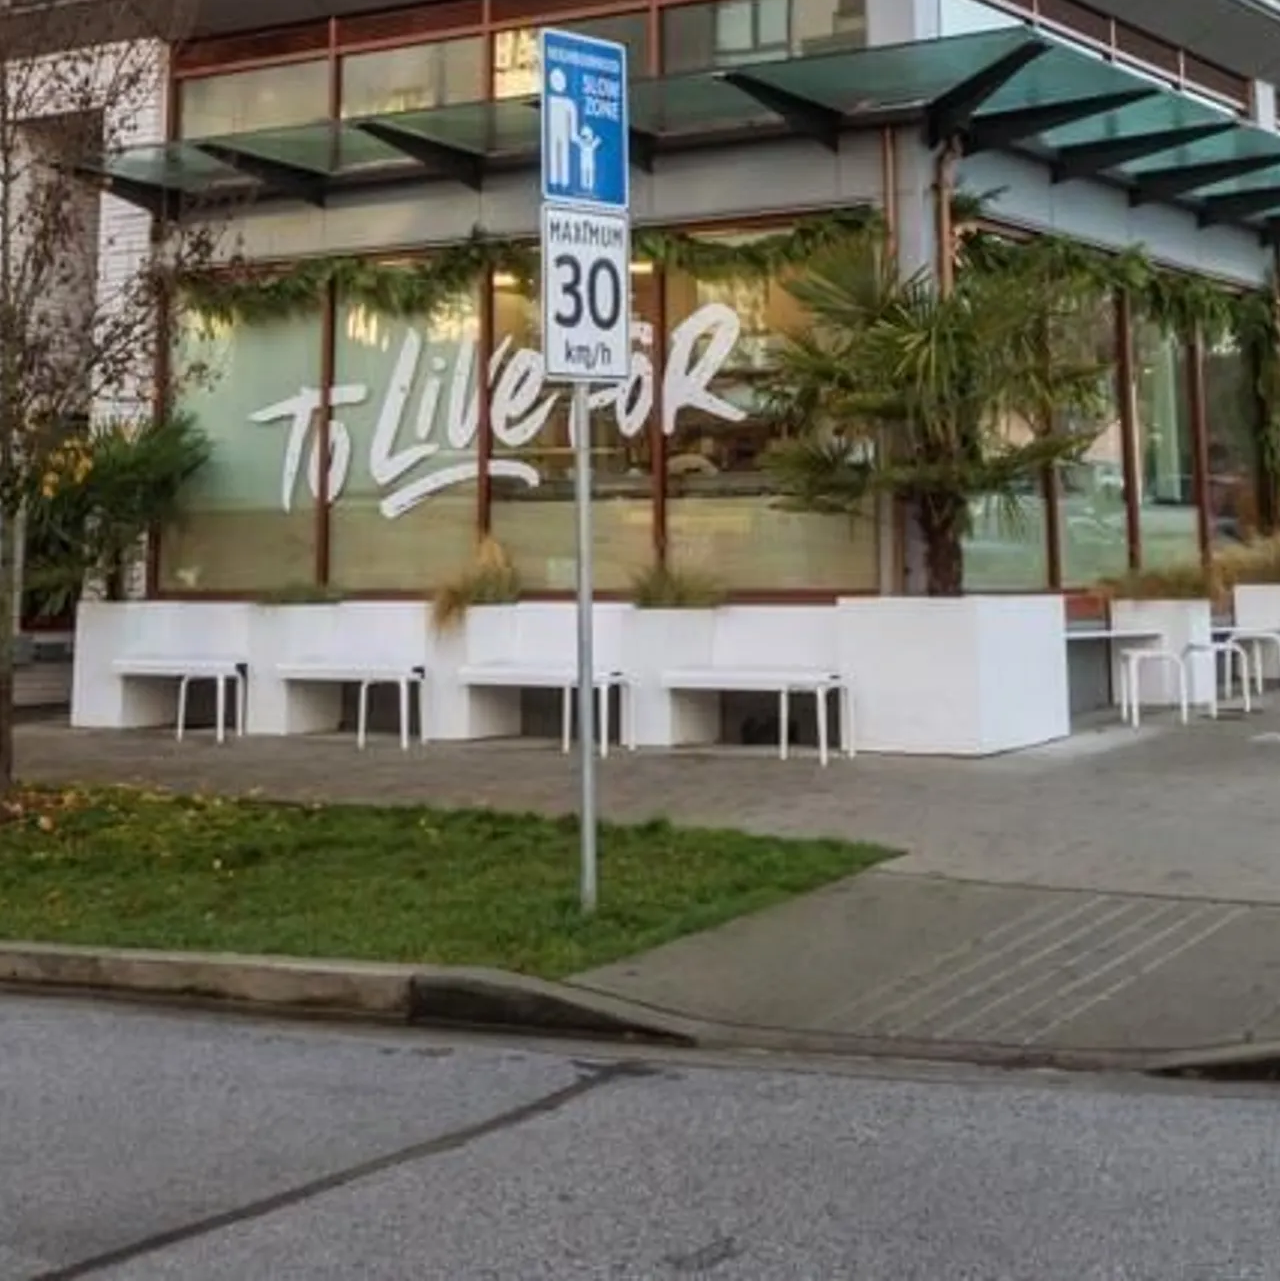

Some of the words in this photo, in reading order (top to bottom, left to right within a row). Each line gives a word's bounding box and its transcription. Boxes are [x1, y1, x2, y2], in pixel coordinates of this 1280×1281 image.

[584, 95, 620, 123] ZONE
[549, 220, 623, 249] MAXIMUM
[554, 254, 621, 331] 30
[564, 339, 612, 369] km/h
